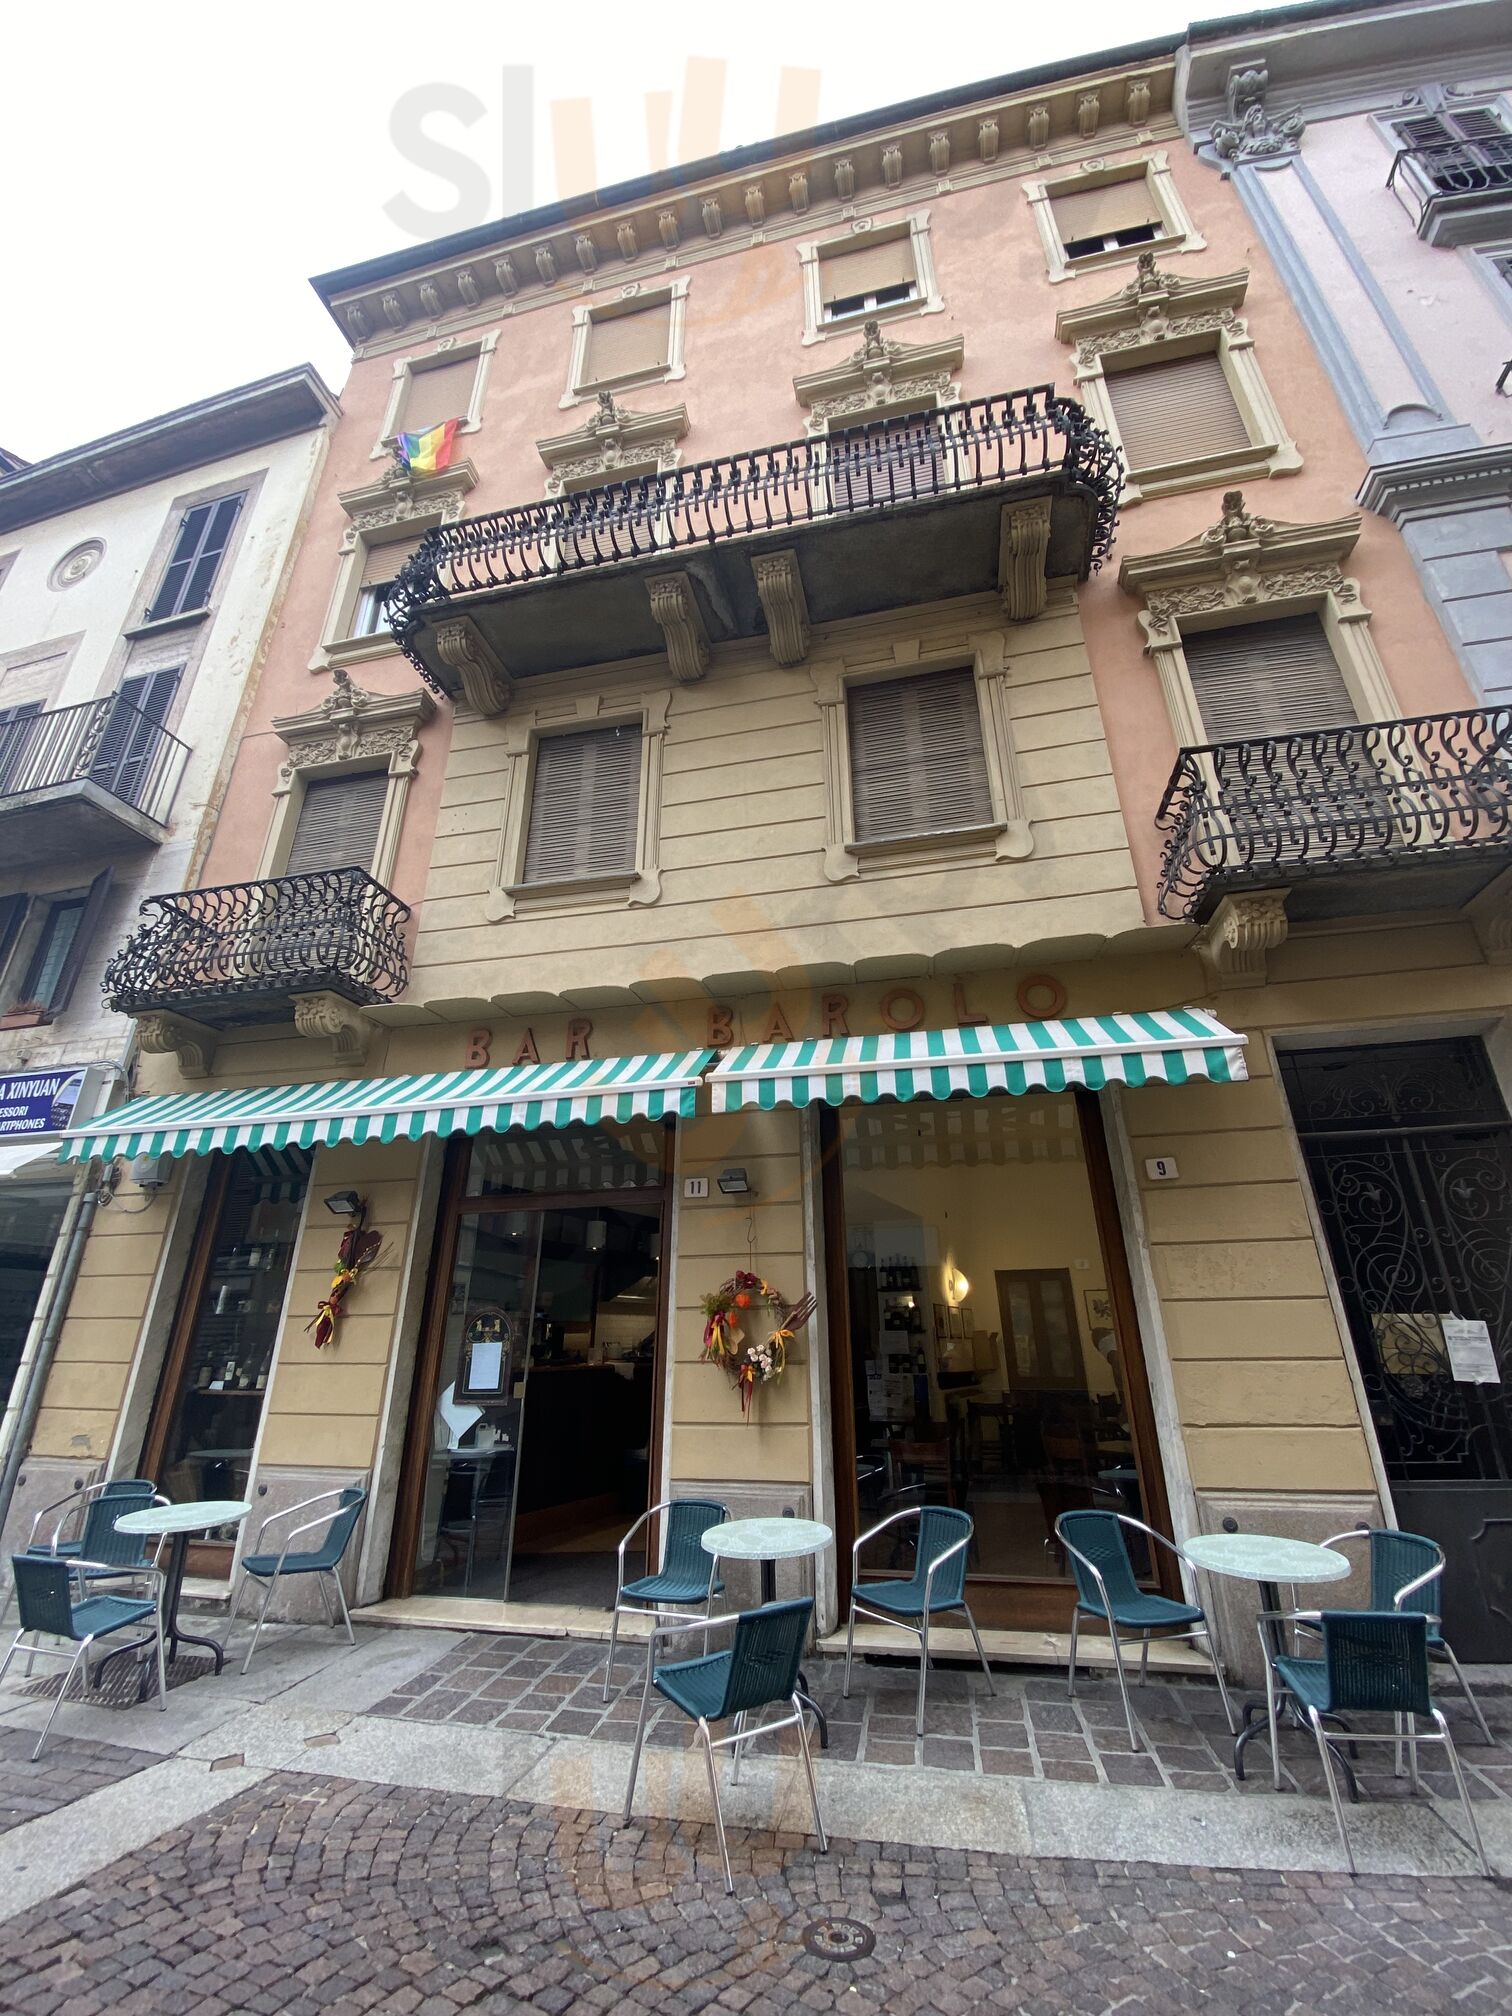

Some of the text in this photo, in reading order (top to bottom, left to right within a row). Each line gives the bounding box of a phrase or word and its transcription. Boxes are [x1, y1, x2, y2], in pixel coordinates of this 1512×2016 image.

[465, 974, 1067, 1069] BAR BAROLO
[6, 1078, 61, 1100] XINYUAN
[1156, 1160, 1167, 1176] 9
[690, 1180, 701, 1195] 11
